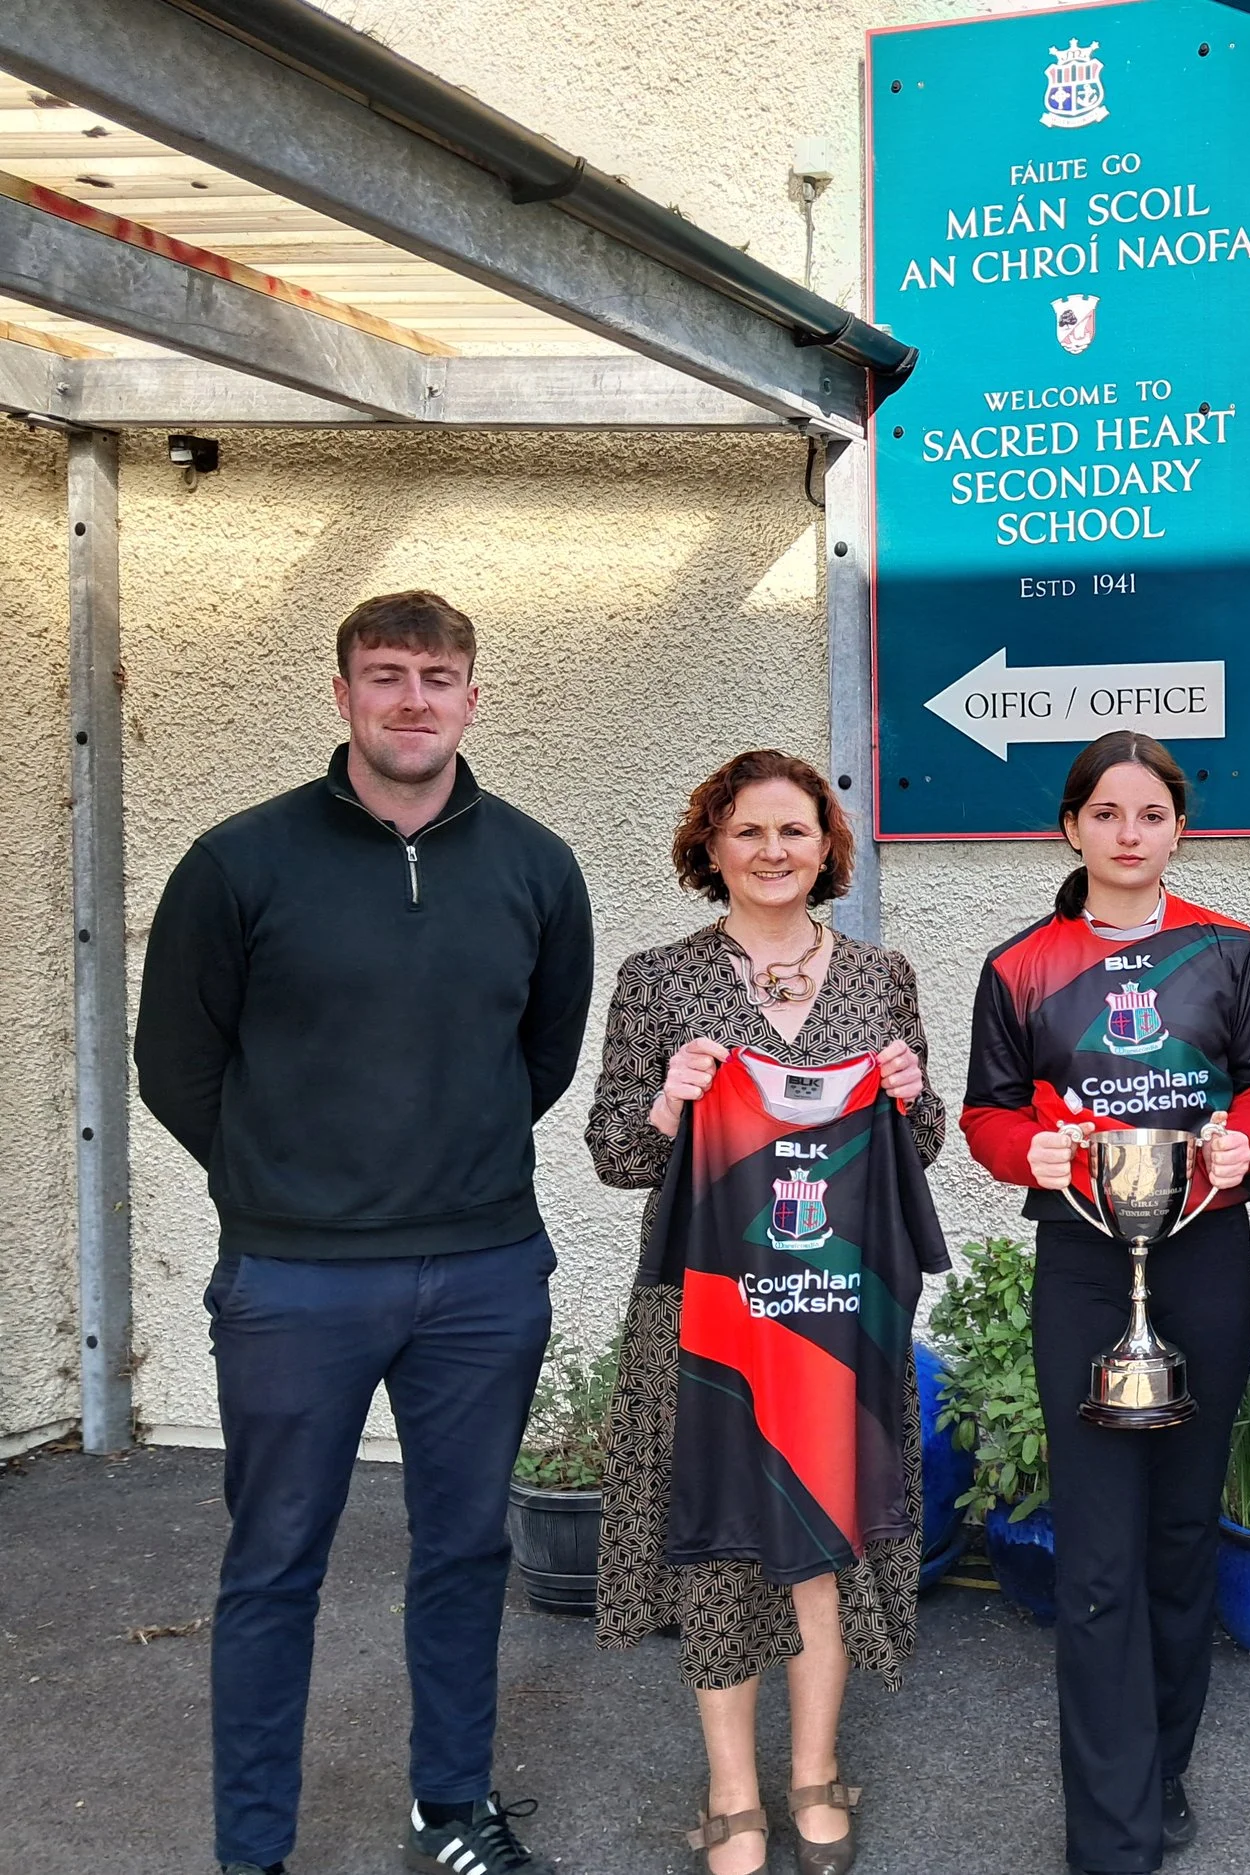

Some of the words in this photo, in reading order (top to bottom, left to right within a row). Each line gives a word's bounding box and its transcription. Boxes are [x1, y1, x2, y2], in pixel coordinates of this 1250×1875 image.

[1010, 158, 1087, 186] FÁILTE
[1102, 153, 1141, 176] GO
[946, 195, 1067, 241] MEÁN
[1087, 184, 1211, 226] SCOIL
[899, 256, 956, 291] AN
[971, 234, 1100, 284] CHROÍ
[984, 383, 1118, 412] WELCOME
[1136, 379, 1172, 402] TO
[922, 422, 1079, 463] SACRED
[1095, 409, 1236, 452] HEART
[951, 458, 1202, 505] SECONDARY
[996, 506, 1166, 546] SCHOOL
[1093, 573, 1136, 595] 1941
[964, 690, 1052, 720] OIFIG
[1090, 686, 1208, 716] OFFICE
[1104, 954, 1154, 971] BLK
[788, 1075, 820, 1087] BLK
[1081, 1069, 1209, 1101] Coughlans
[1093, 1089, 1207, 1118] Bookshop
[775, 1140, 829, 1160] BLK
[749, 1292, 861, 1318] Booksho
